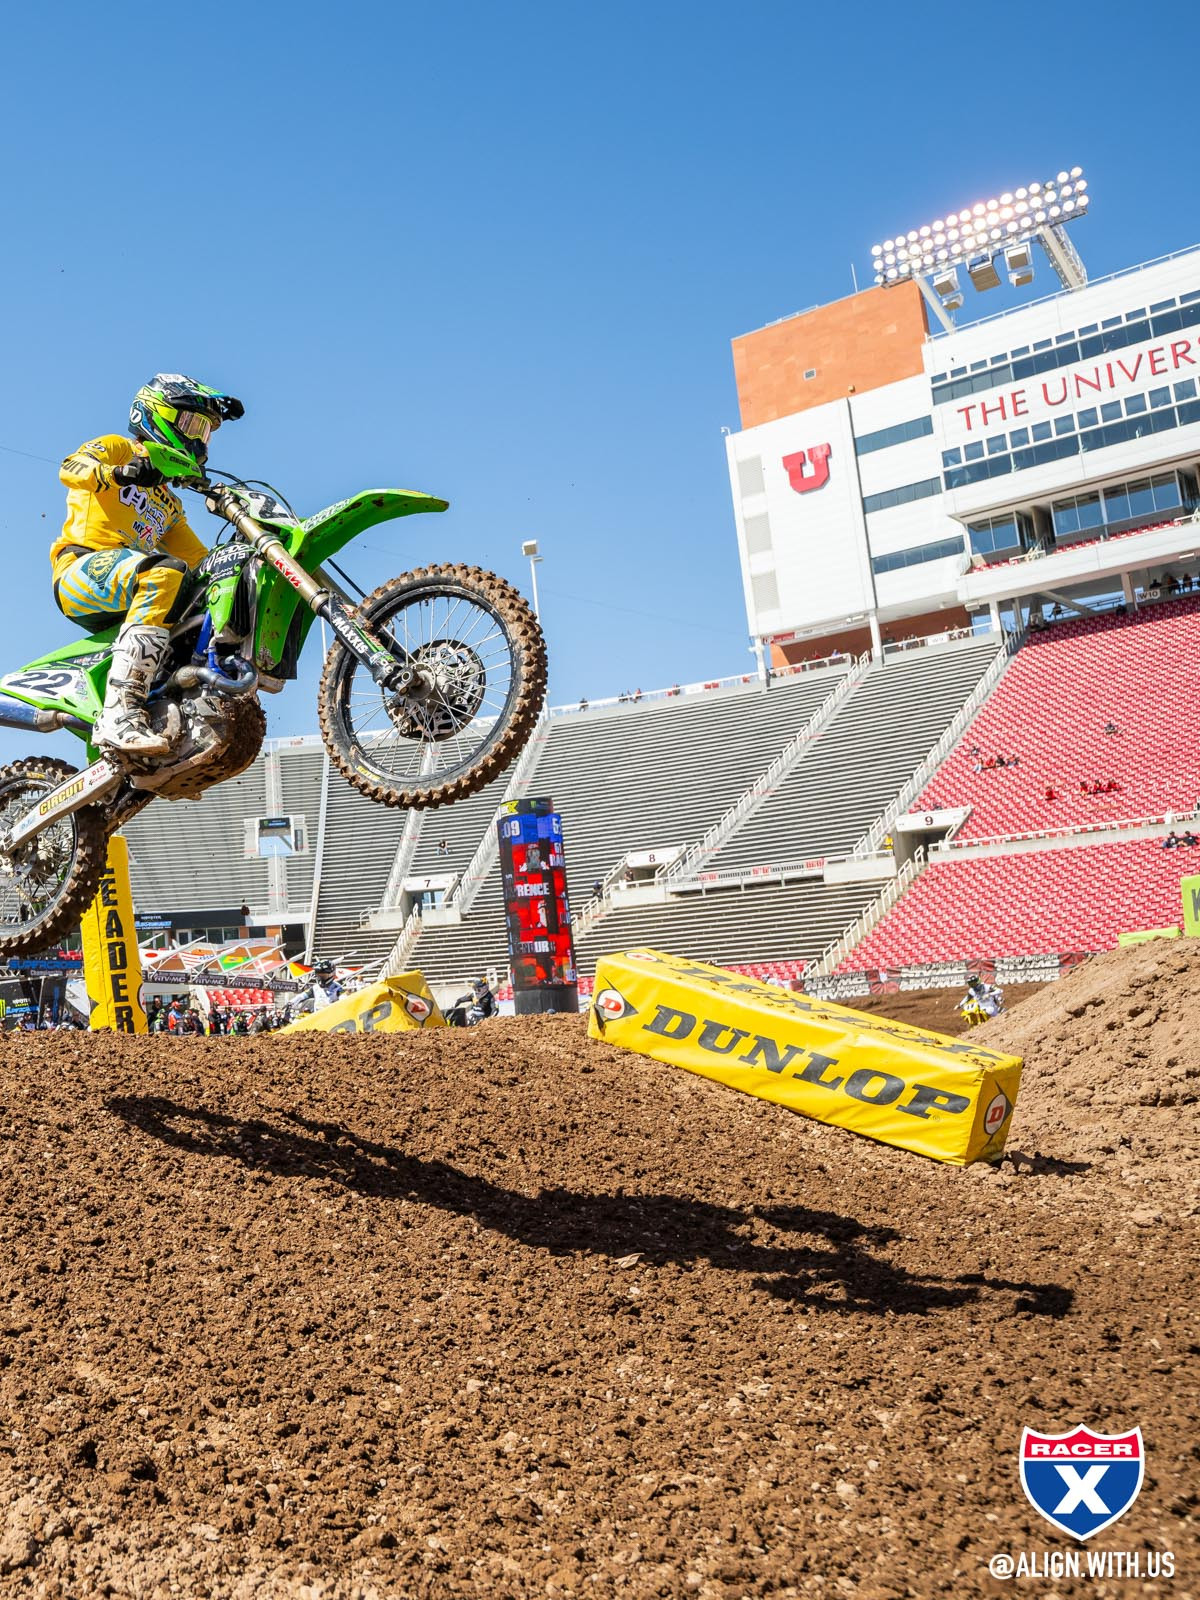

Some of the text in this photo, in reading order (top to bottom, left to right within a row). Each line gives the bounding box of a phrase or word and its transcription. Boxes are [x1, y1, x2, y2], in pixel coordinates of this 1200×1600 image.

[956, 338, 1200, 431] THE UNIVER
[782, 443, 830, 493] U
[274, 558, 302, 589] KYB
[332, 617, 369, 654] MAXXIS
[6, 672, 73, 696] 22
[40, 776, 85, 816] CIRCUIT
[924, 816, 934, 826] 9
[648, 854, 656, 862] 8
[424, 880, 431, 888] 7
[642, 1004, 971, 1119] DUNLOP
[987, 1106, 1004, 1124] D
